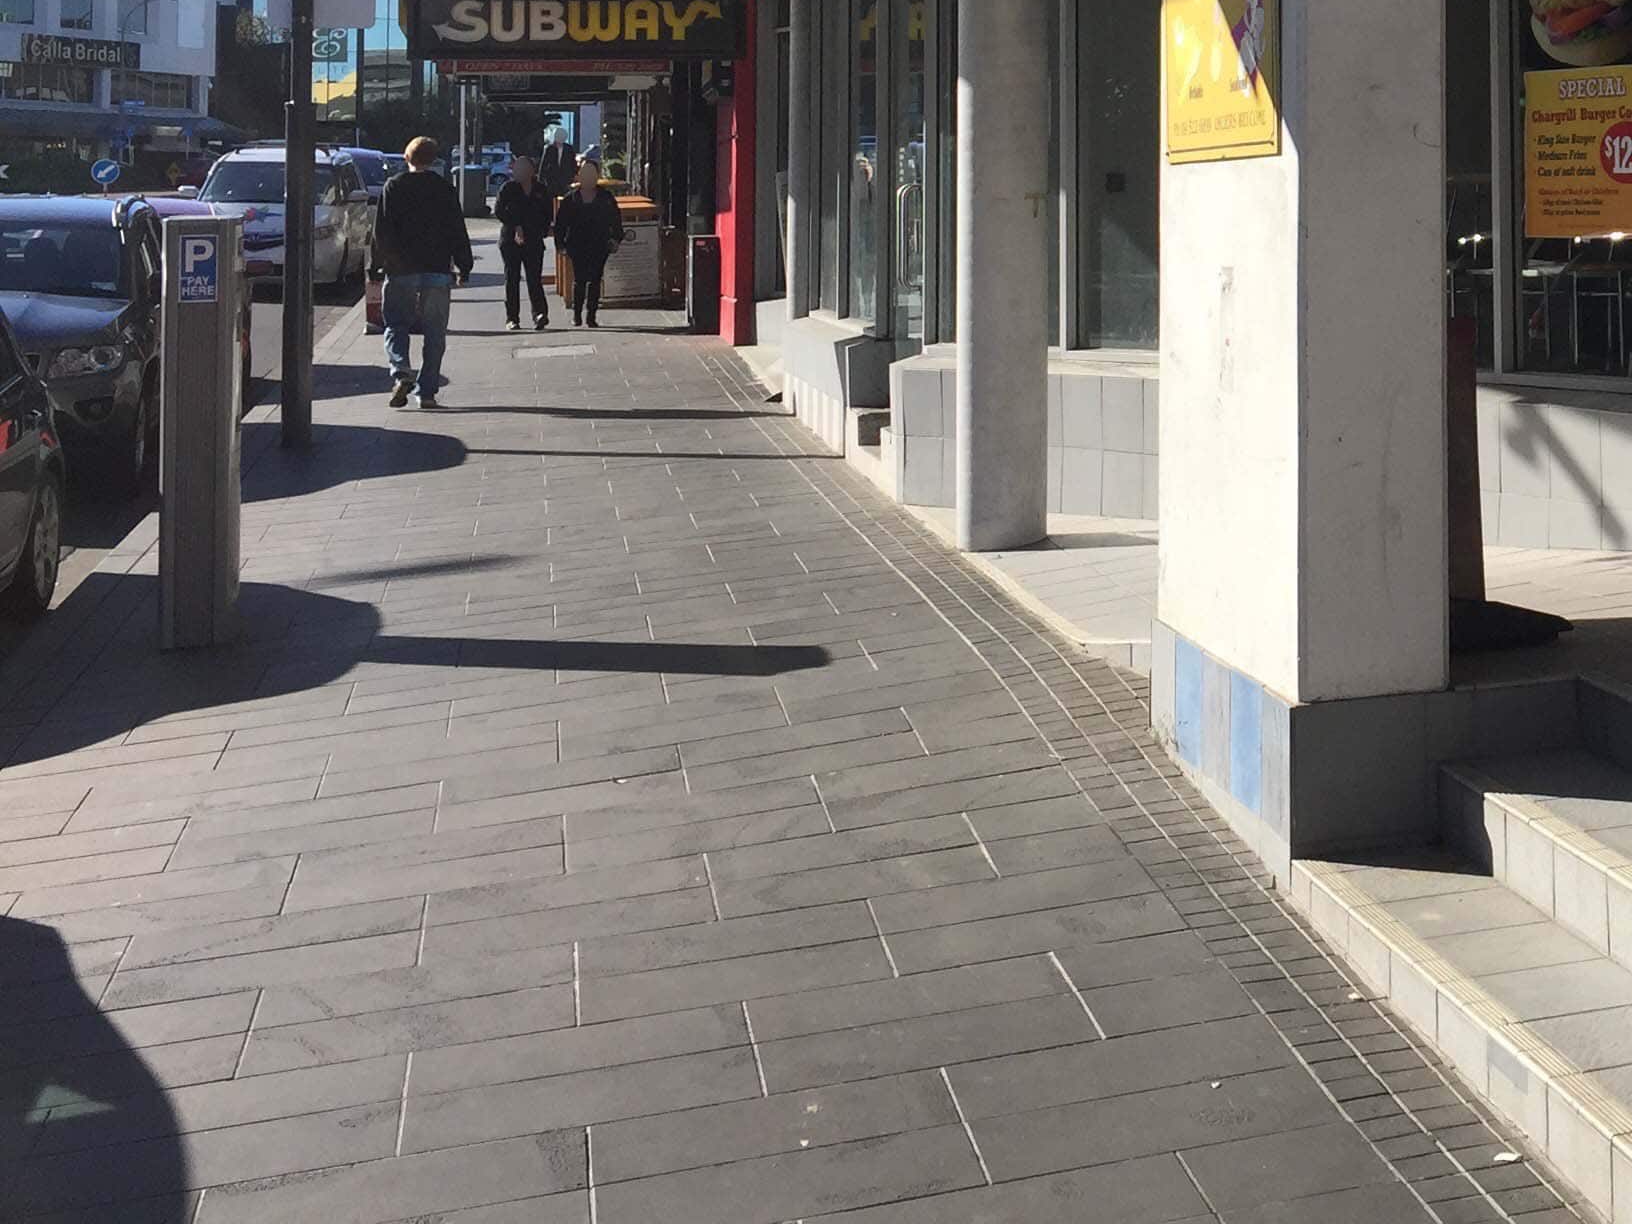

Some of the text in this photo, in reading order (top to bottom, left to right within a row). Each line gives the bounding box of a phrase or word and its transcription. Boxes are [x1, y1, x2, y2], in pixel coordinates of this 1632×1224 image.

[432, 0, 723, 43] SUBWAY
[30, 39, 121, 63] Calla Bridal
[1559, 76, 1627, 100] SPECIAL
[1532, 109, 1577, 125] Chargrill
[1580, 107, 1617, 123] Burger
[185, 239, 214, 273] P
[182, 285, 215, 296] HERE
[187, 275, 209, 286] PAY
